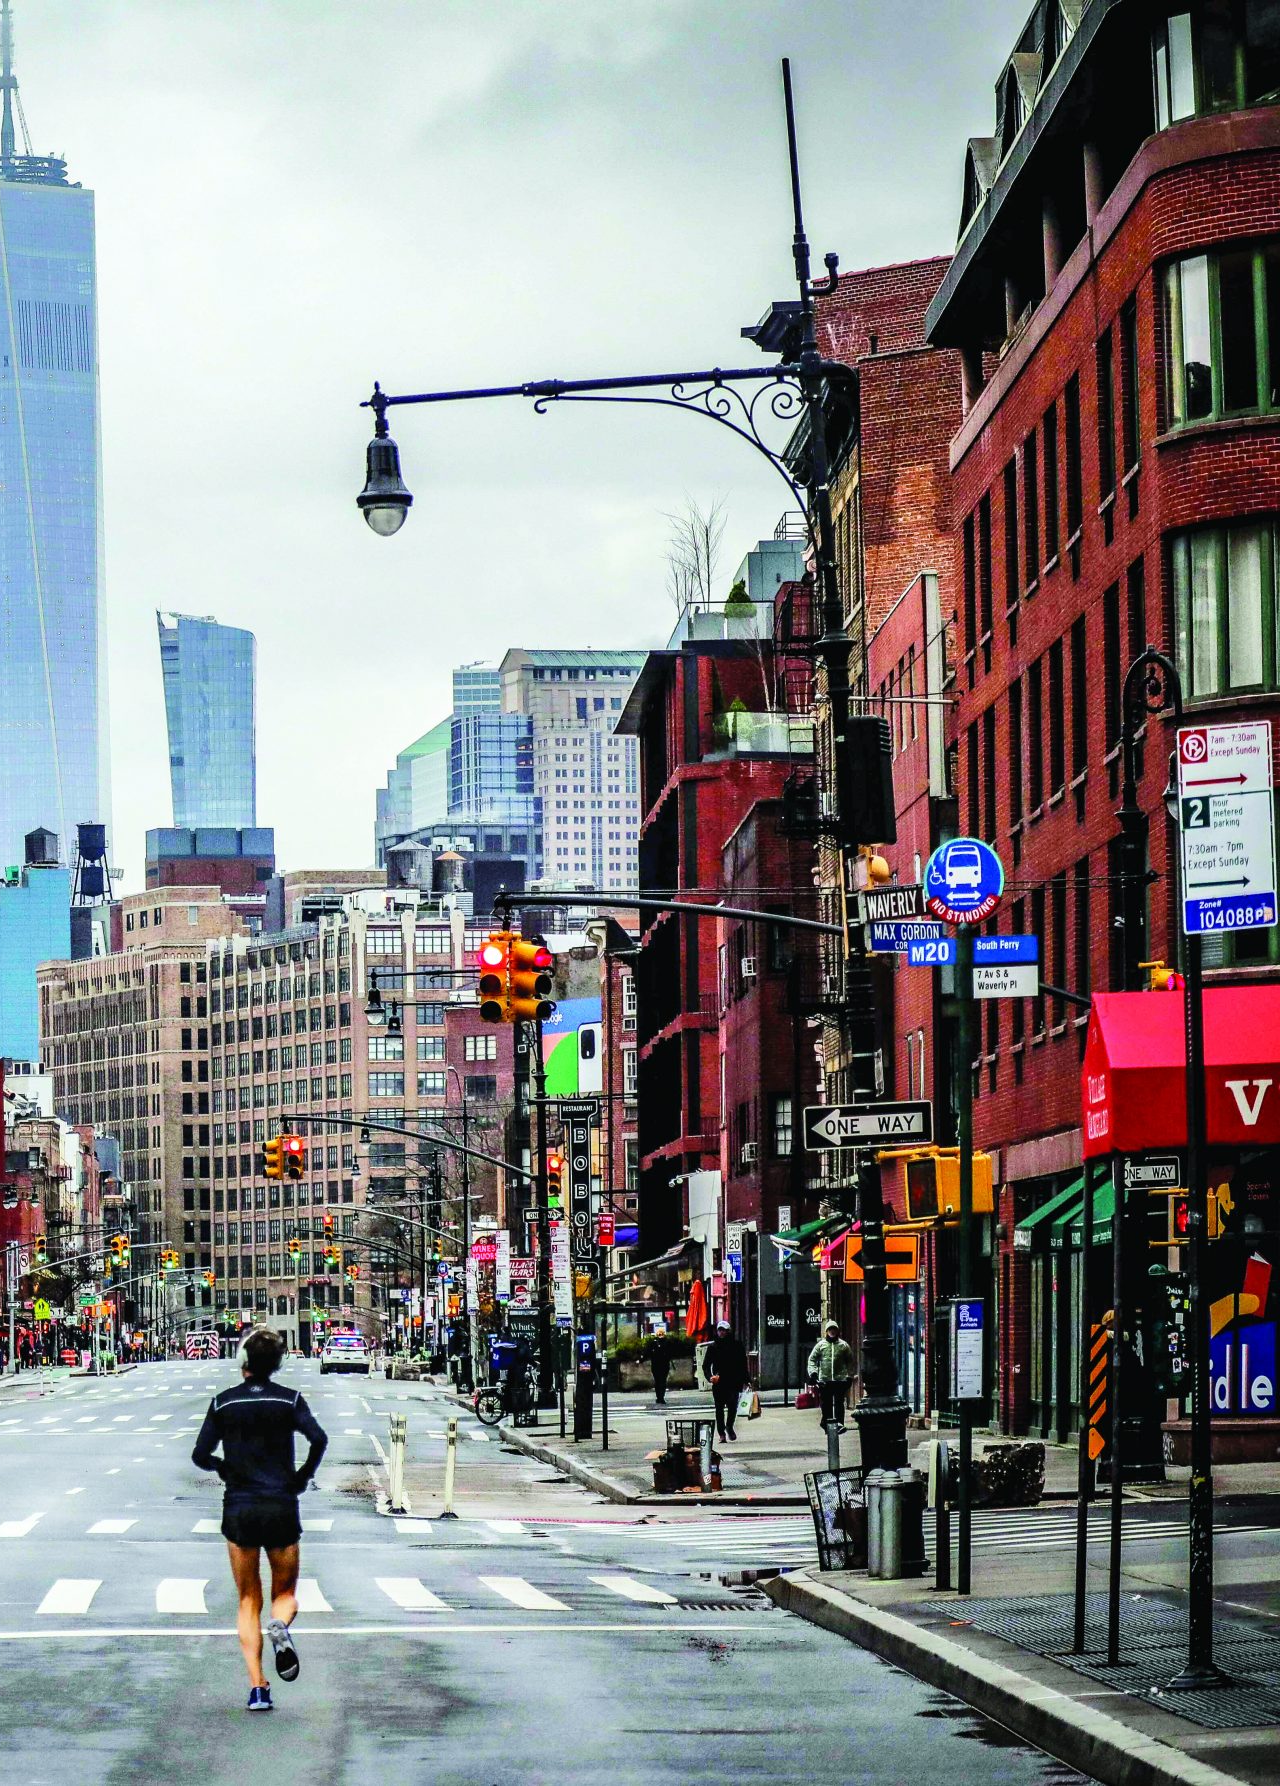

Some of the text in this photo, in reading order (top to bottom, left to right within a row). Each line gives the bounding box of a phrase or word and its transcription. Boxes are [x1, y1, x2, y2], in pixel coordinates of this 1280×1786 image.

[1210, 736, 1225, 745] 7am
[1231, 733, 1257, 743] 7:30am
[1210, 746, 1261, 757] Except Sunday
[1212, 799, 1229, 807] hour
[1189, 799, 1204, 827] 2
[1213, 807, 1243, 818] metered
[1213, 818, 1240, 828] parking
[1188, 844, 1218, 854] 7:30am
[1227, 841, 1244, 853] 7pm
[1188, 855, 1249, 870] Except Sunday
[867, 891, 918, 920] WAVERLY
[1199, 900, 1222, 909] Zone#
[931, 899, 945, 916] NO
[946, 897, 996, 924] STANDING
[1200, 907, 1254, 928] 104088
[874, 924, 940, 941] MAX GORDON
[976, 939, 1020, 951] South Ferry
[911, 942, 950, 962] M20
[978, 969, 1009, 979] 7 Av S &
[977, 980, 1017, 991] Waverly Pl
[542, 1010, 563, 1025] ogle
[825, 1115, 915, 1136] ONE WAY
[1152, 1166, 1173, 1179] WAY
[472, 1245, 496, 1253] WINES
[728, 1239, 740, 1250] 20
[510, 1261, 535, 1269] ILLAGE
[510, 1269, 534, 1278] IGARS
[510, 1322, 536, 1331] What's
[582, 1342, 590, 1352] P
